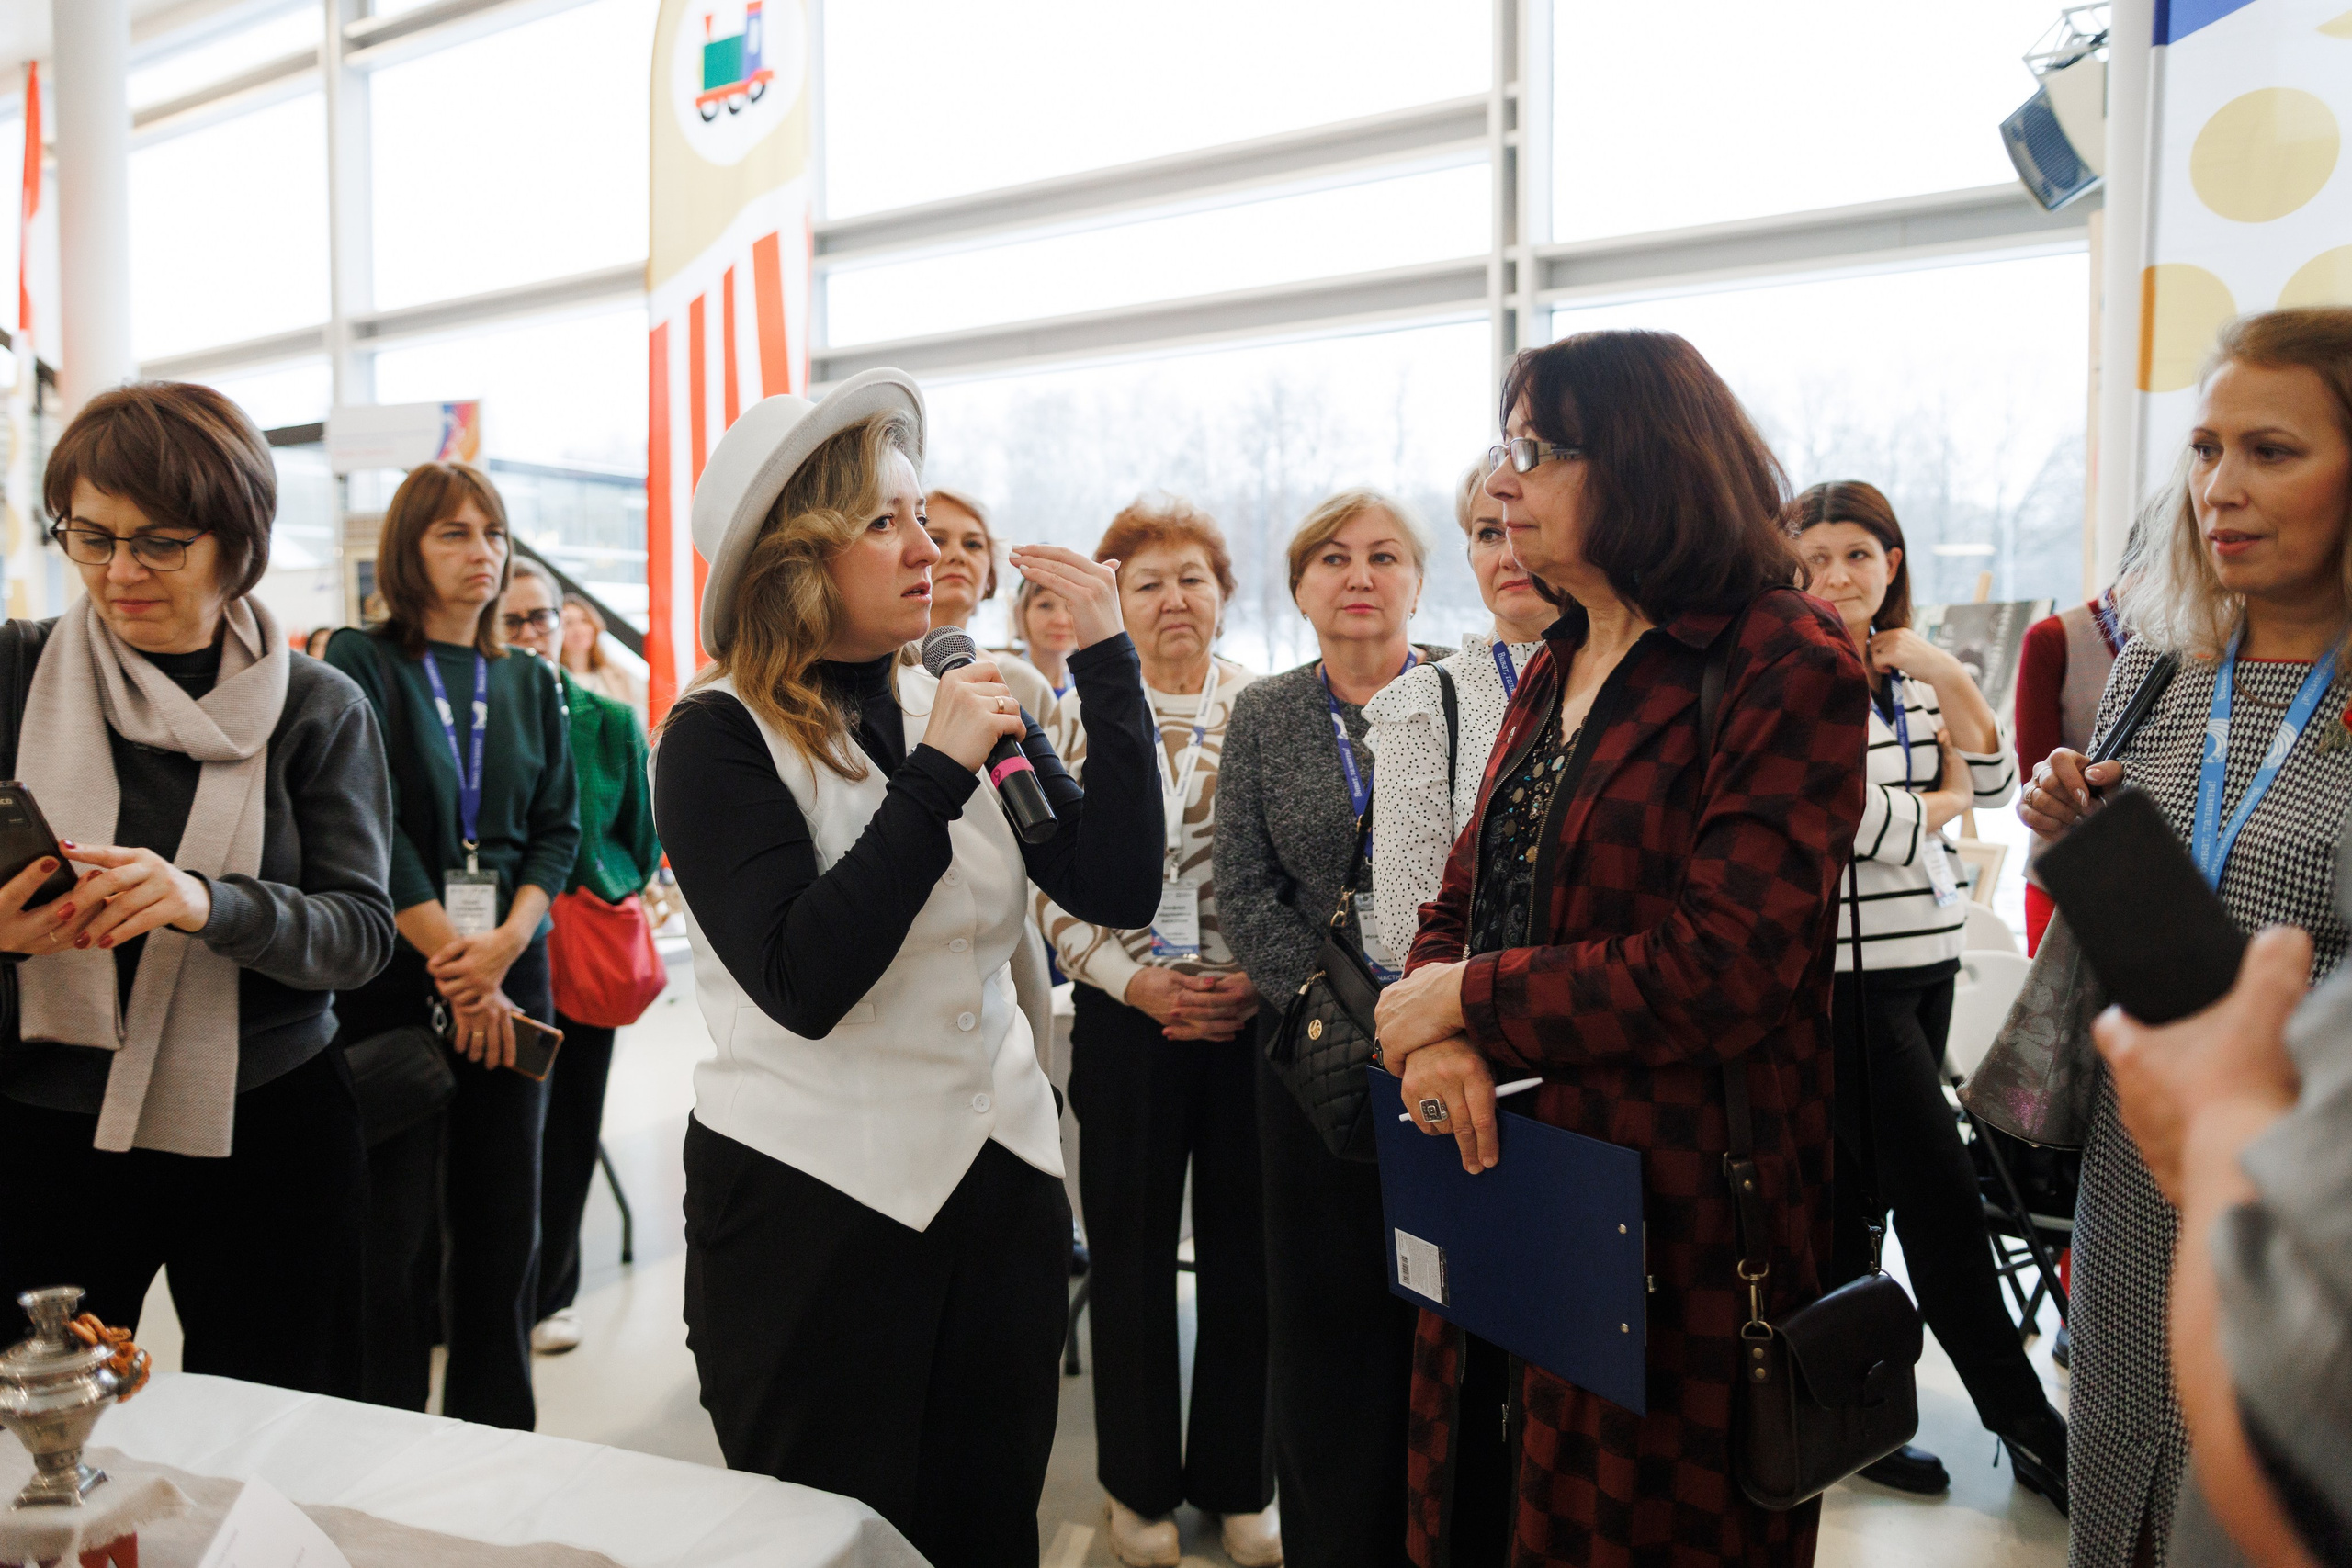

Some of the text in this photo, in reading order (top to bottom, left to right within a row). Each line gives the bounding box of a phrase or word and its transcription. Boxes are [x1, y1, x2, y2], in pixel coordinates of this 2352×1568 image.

[1497, 651, 1516, 694] Виват, тала
[2217, 664, 2229, 701] Виват,
[2301, 671, 2325, 706] анты!
[1351, 775, 1363, 797] Виват,
[2203, 780, 2216, 833] таланты!
[2233, 787, 2262, 822] Виват,
